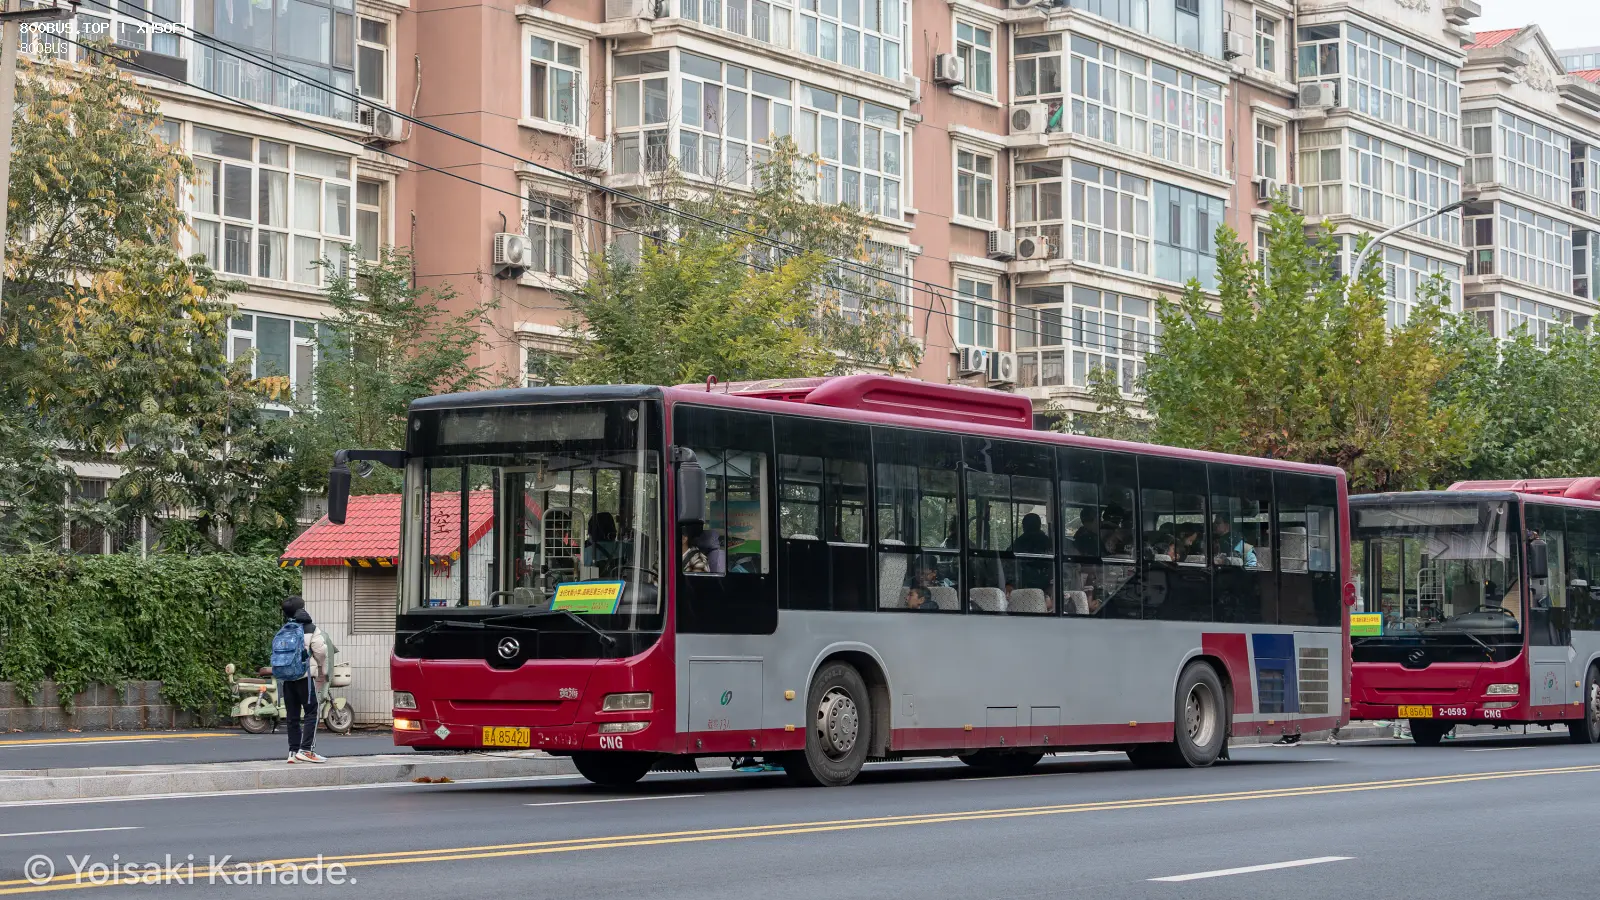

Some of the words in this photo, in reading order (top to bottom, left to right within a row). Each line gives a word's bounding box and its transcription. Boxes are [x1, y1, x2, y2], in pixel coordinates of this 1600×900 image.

[559, 687, 578, 699] 黄海
[1439, 707, 1467, 716] 2-0593
[1484, 709, 1501, 718] CNG
[600, 736, 623, 749] CNG
